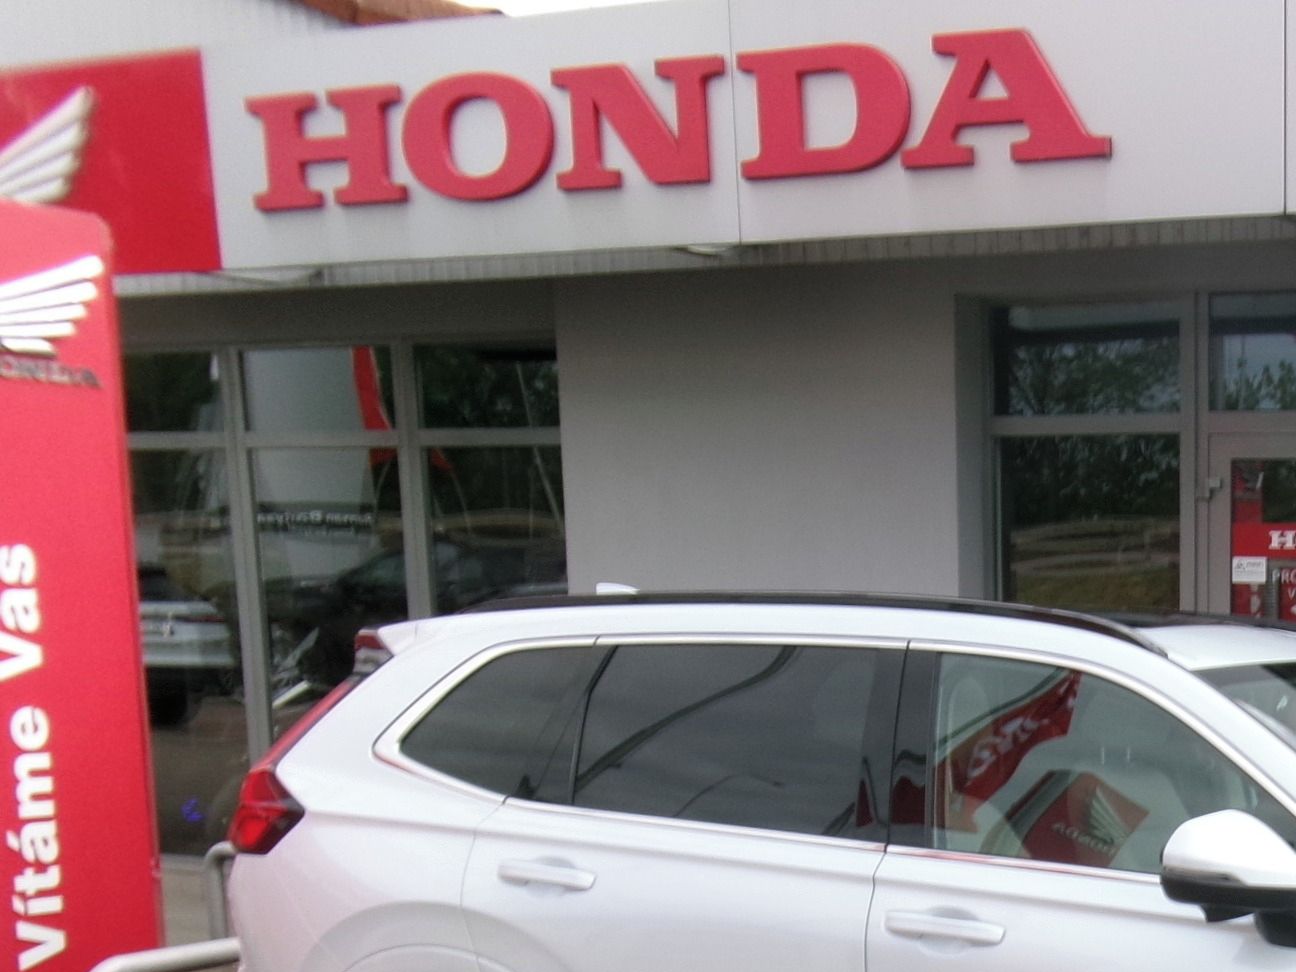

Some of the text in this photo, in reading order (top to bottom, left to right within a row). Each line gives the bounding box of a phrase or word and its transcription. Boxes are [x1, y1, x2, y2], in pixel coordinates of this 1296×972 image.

[245, 27, 1112, 213] HONDA
[0, 354, 103, 388] ONDA
[9, 705, 67, 971] Vítáme
